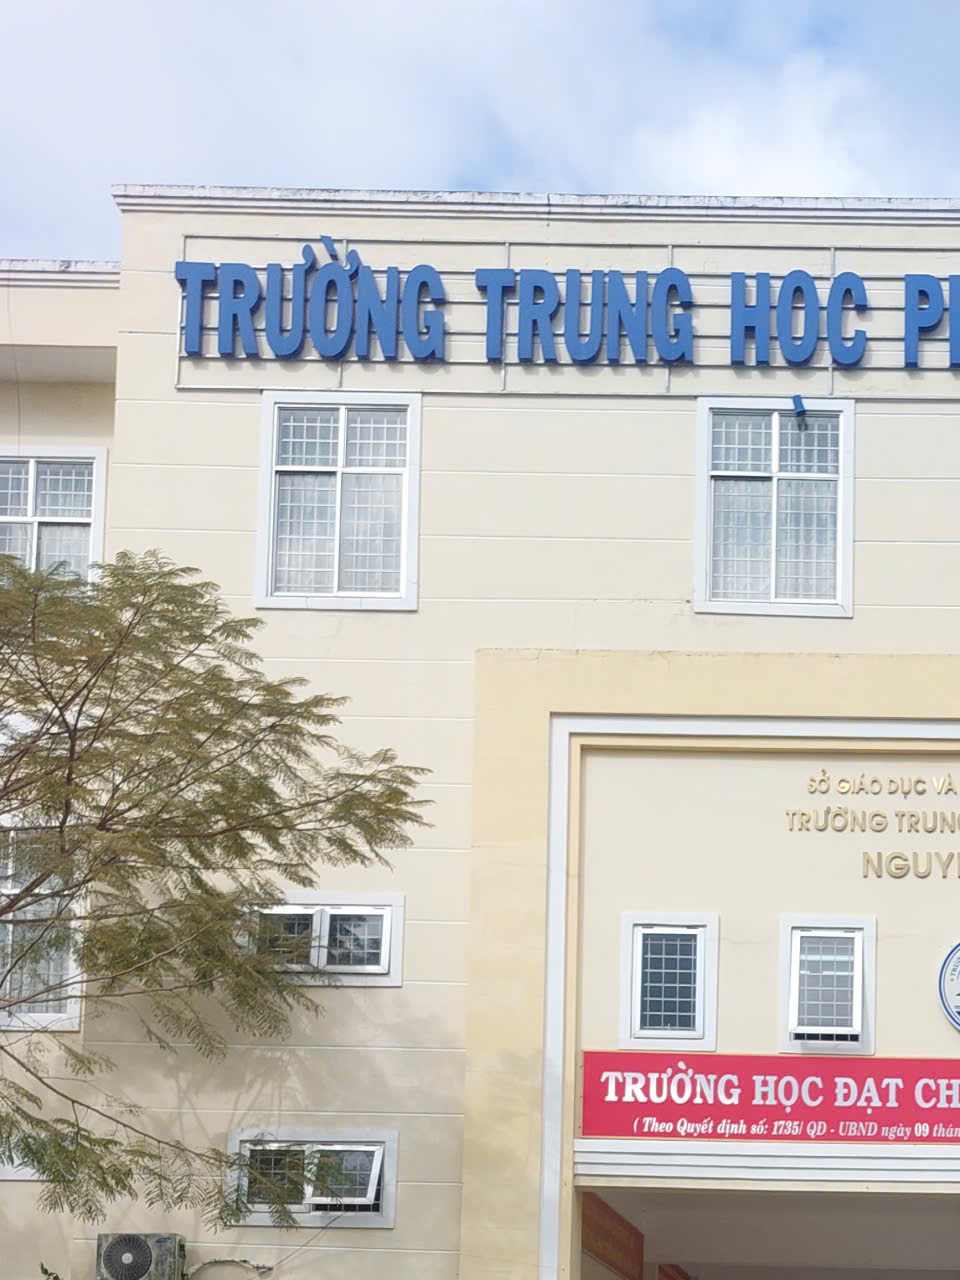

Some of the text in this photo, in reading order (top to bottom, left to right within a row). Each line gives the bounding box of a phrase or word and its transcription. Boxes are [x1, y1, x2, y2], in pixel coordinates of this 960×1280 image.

[175, 236, 445, 361] TRƯỜNG
[475, 267, 694, 364] TRUNG
[808, 769, 830, 794] SỞ
[836, 773, 882, 795] GIÁO
[888, 777, 926, 799] DỤC
[933, 773, 957, 795] VÀ
[786, 806, 888, 833] TRƯỜNG
[600, 1061, 741, 1105] TRƯỜNG
[752, 1074, 824, 1113] HỌC
[834, 1076, 904, 1115] ĐẠT
[643, 1117, 673, 1133] Theo
[676, 1117, 713, 1136] Quyết
[717, 1119, 747, 1137] định
[751, 1118, 768, 1135] số:
[806, 1121, 827, 1138] QĐ
[839, 1121, 878, 1137] UBND
[881, 1123, 912, 1140] ngày
[914, 1122, 930, 1137] 09
